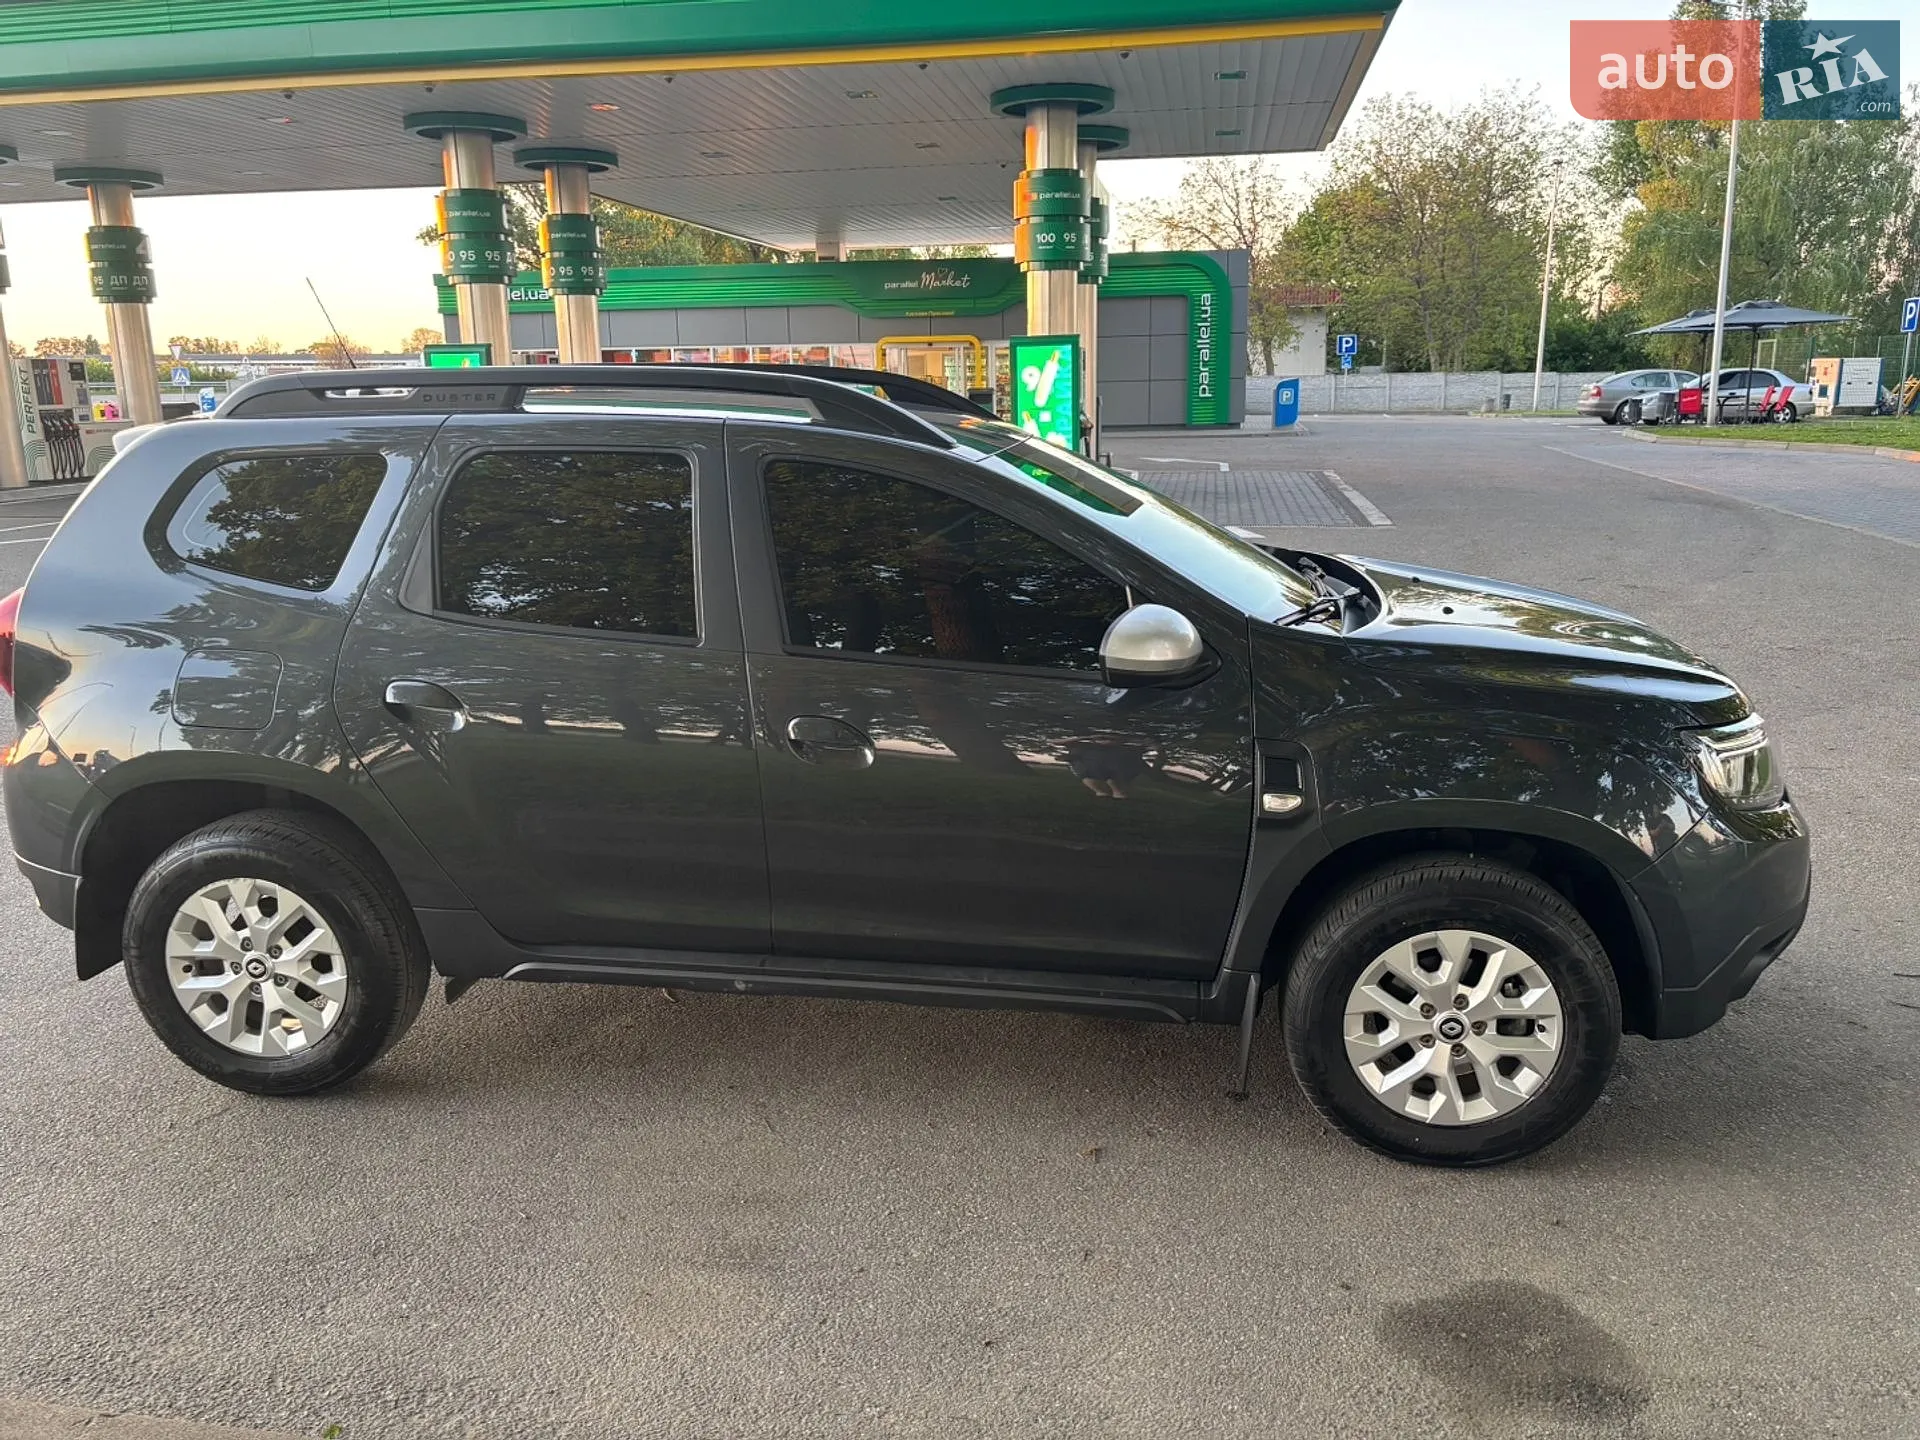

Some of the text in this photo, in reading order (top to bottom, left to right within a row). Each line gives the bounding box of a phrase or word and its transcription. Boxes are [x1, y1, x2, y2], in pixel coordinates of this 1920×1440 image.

[1036, 233, 1056, 243] 100
[1063, 233, 1077, 243] 95
[459, 250, 476, 261] 95
[485, 250, 501, 261] 95
[559, 266, 574, 276] 95
[581, 266, 594, 276] 95
[884, 271, 972, 290] parallel Market
[1198, 292, 1213, 398] parallel.ua
[20, 367, 36, 434] PERFEKT
[423, 393, 496, 403] DUSTER
